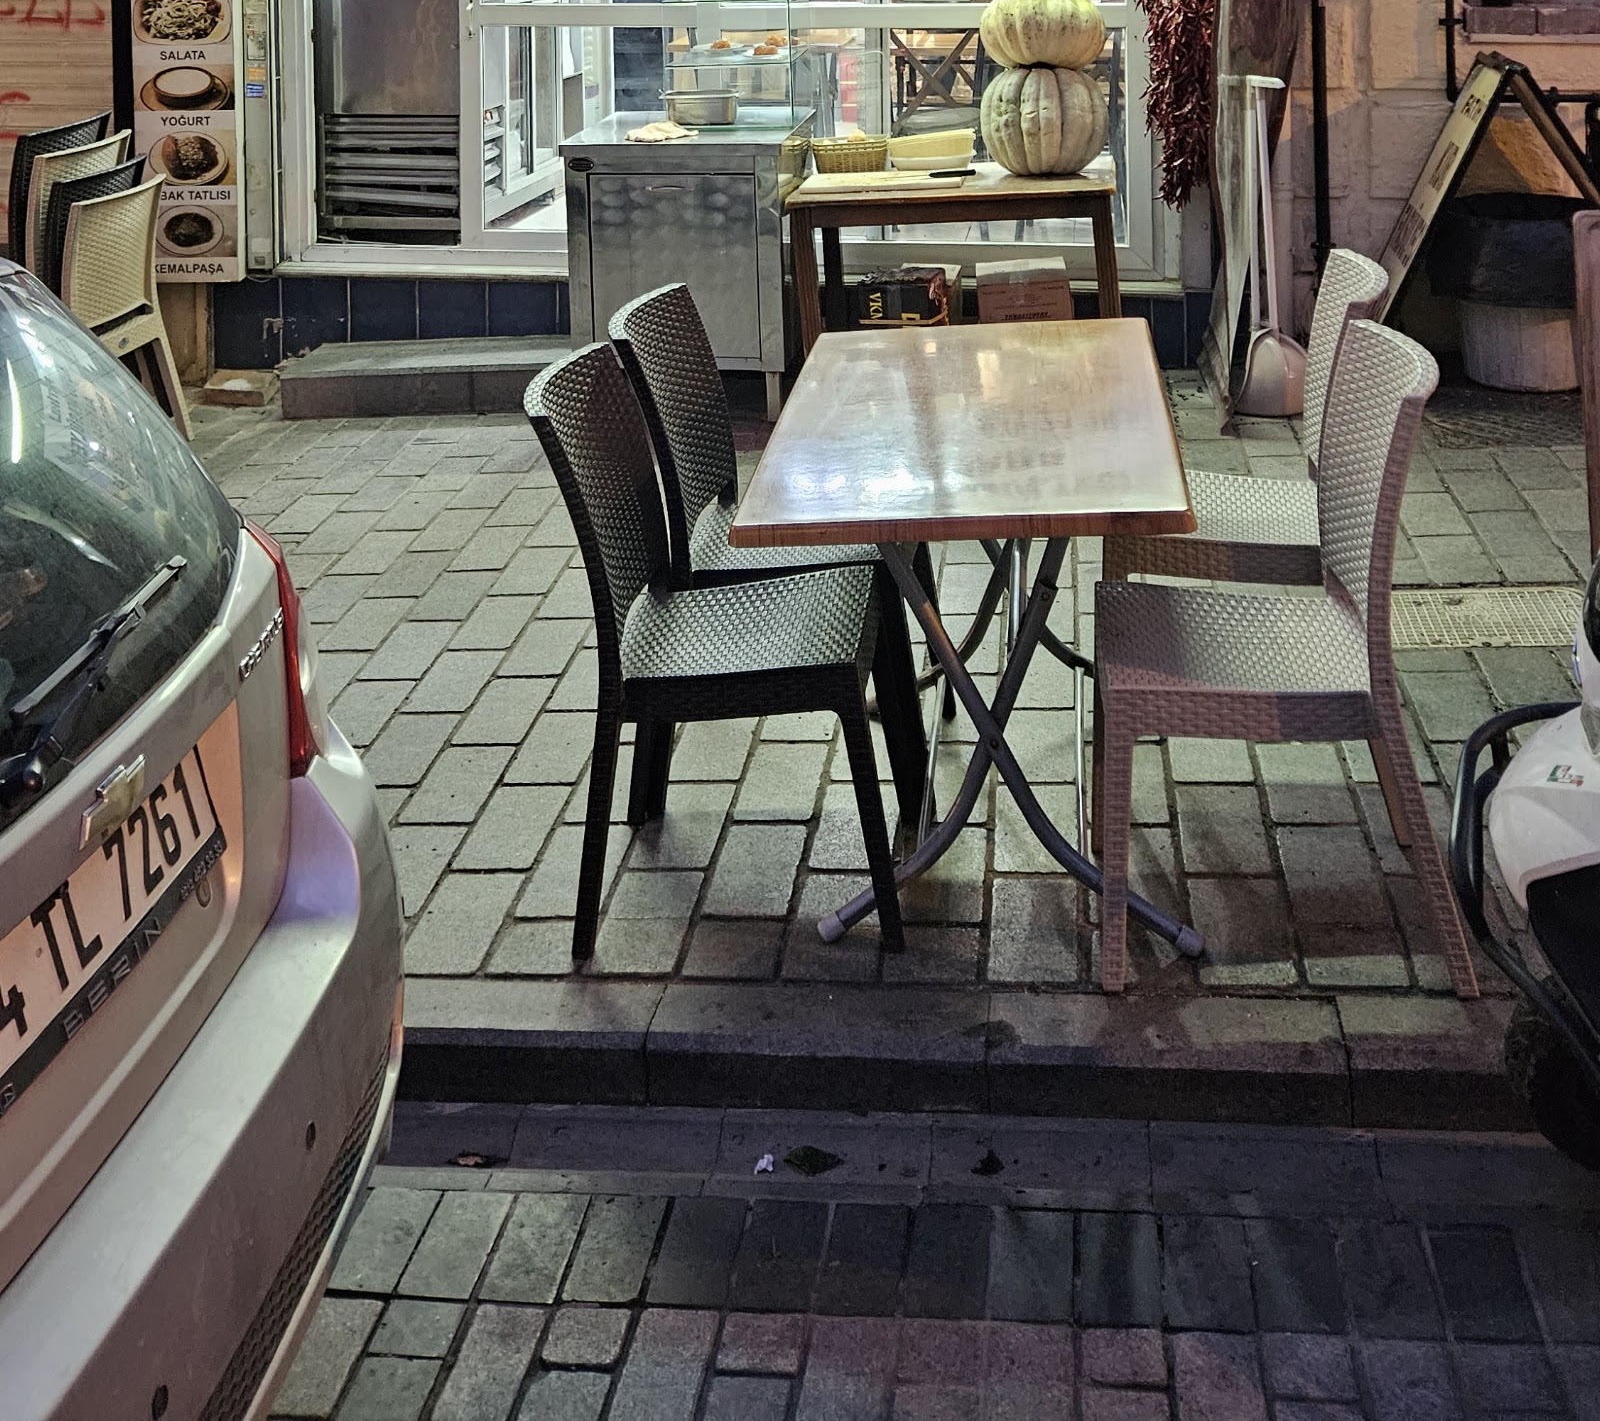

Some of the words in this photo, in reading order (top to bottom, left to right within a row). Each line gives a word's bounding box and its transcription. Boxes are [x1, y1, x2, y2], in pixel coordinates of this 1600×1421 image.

[159, 50, 206, 61] SALATA
[160, 115, 211, 127] YOĞURT
[160, 190, 185, 201] BAK
[187, 190, 231, 201] TATLISI
[30, 879, 103, 993] TL
[102, 762, 202, 923] 7261
